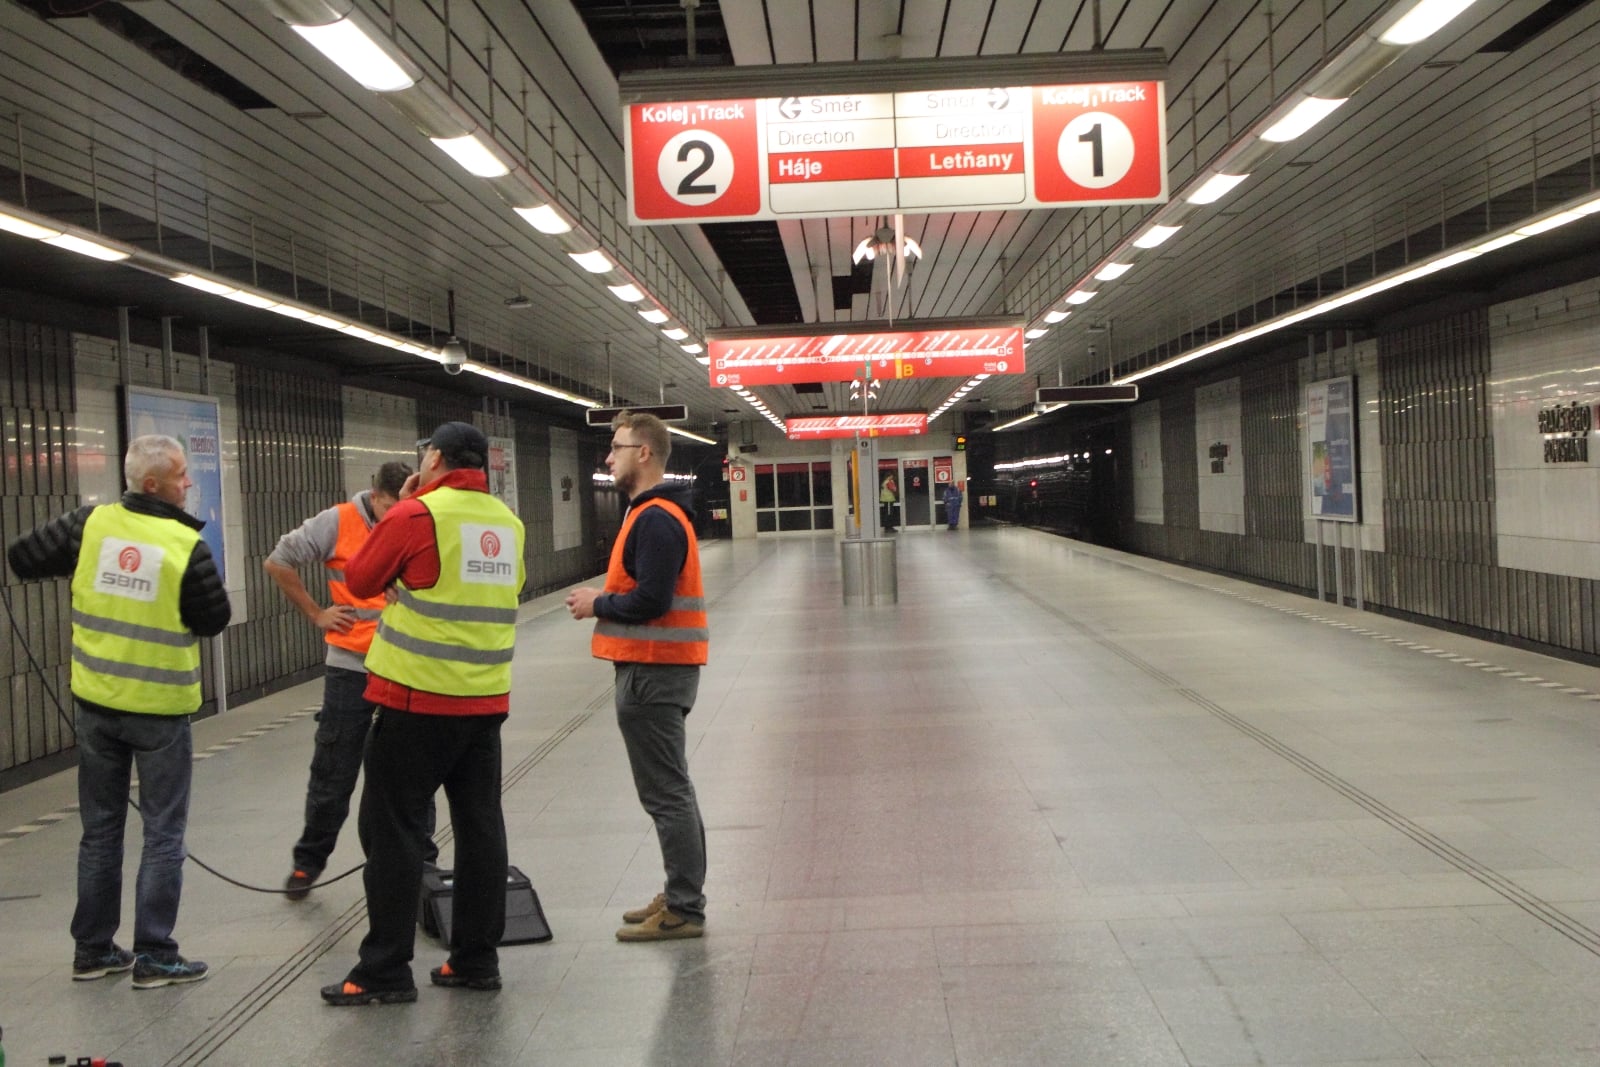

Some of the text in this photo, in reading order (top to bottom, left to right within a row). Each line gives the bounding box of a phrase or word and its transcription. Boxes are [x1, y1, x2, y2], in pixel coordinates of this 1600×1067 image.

[1041, 85, 1146, 107] Kolej Track
[641, 104, 745, 125] Kolej Track
[778, 130, 855, 146] Direction
[936, 123, 1012, 139] Direction
[1078, 122, 1104, 178] 1
[677, 139, 717, 195] 2
[778, 158, 822, 179] Háje
[929, 151, 1014, 171] Letňany
[903, 364, 914, 377] B
[466, 560, 512, 576] SBM
[101, 571, 152, 592] SBM
